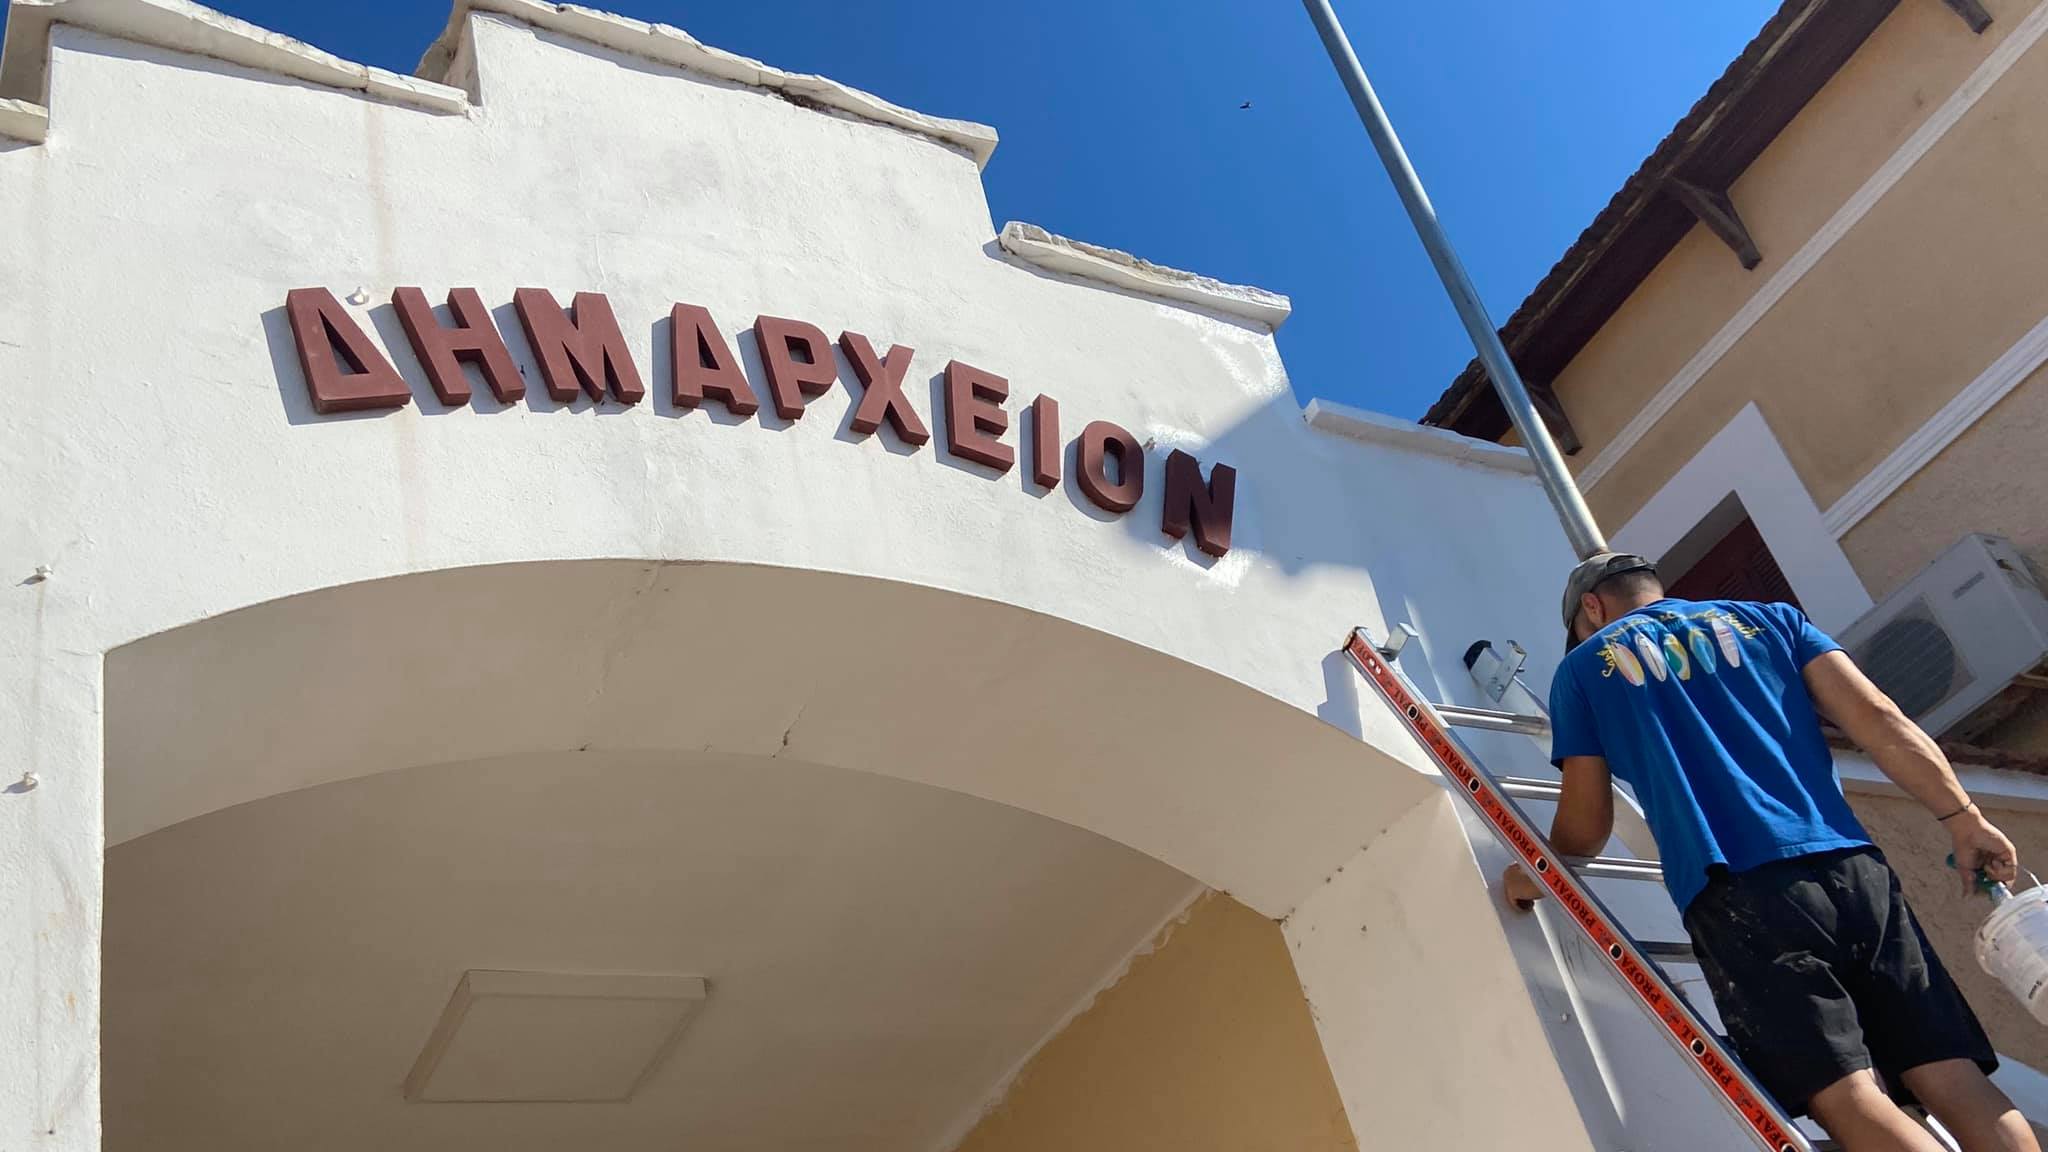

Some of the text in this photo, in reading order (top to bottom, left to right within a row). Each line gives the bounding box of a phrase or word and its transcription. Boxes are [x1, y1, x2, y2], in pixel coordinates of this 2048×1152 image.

[287, 287, 1236, 557] ΔΗΜΑΡΧΕΙΟΝ
[1493, 808, 1535, 856] PROFAL
[1551, 876, 1595, 926] PROFAL
[1621, 956, 1660, 1002] PROFA
